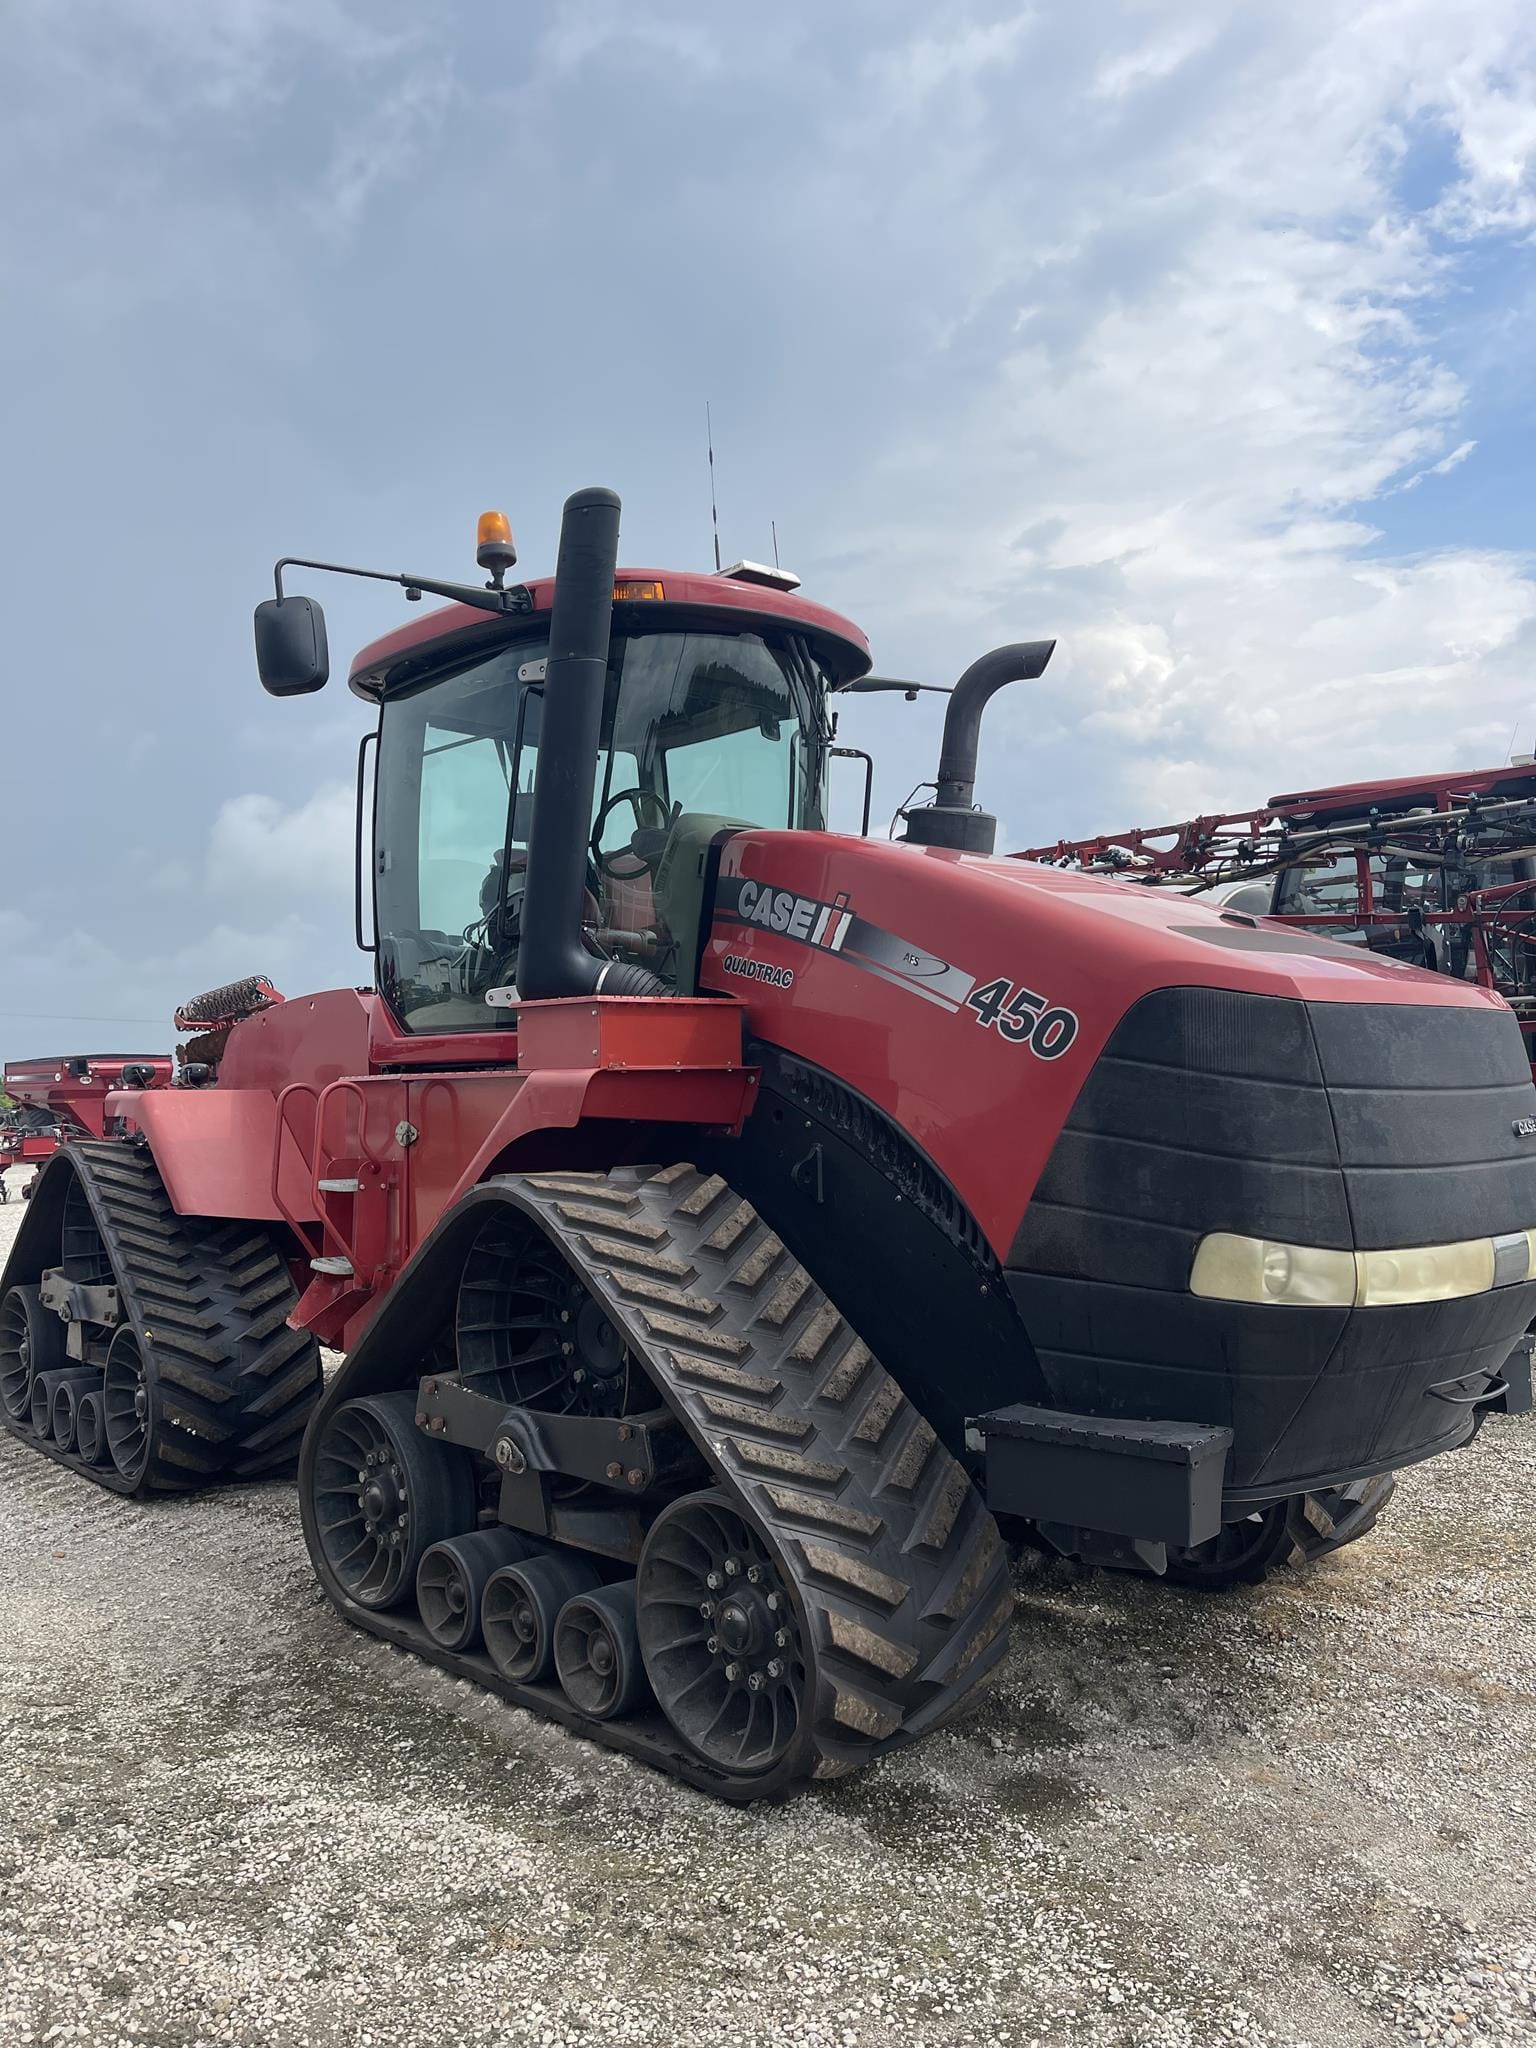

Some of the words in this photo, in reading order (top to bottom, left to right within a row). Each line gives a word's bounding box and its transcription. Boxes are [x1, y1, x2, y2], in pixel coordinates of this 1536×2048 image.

[723, 954, 794, 989] QUADTRAC
[903, 952, 920, 967] AFS
[966, 976, 1079, 1061] 450
